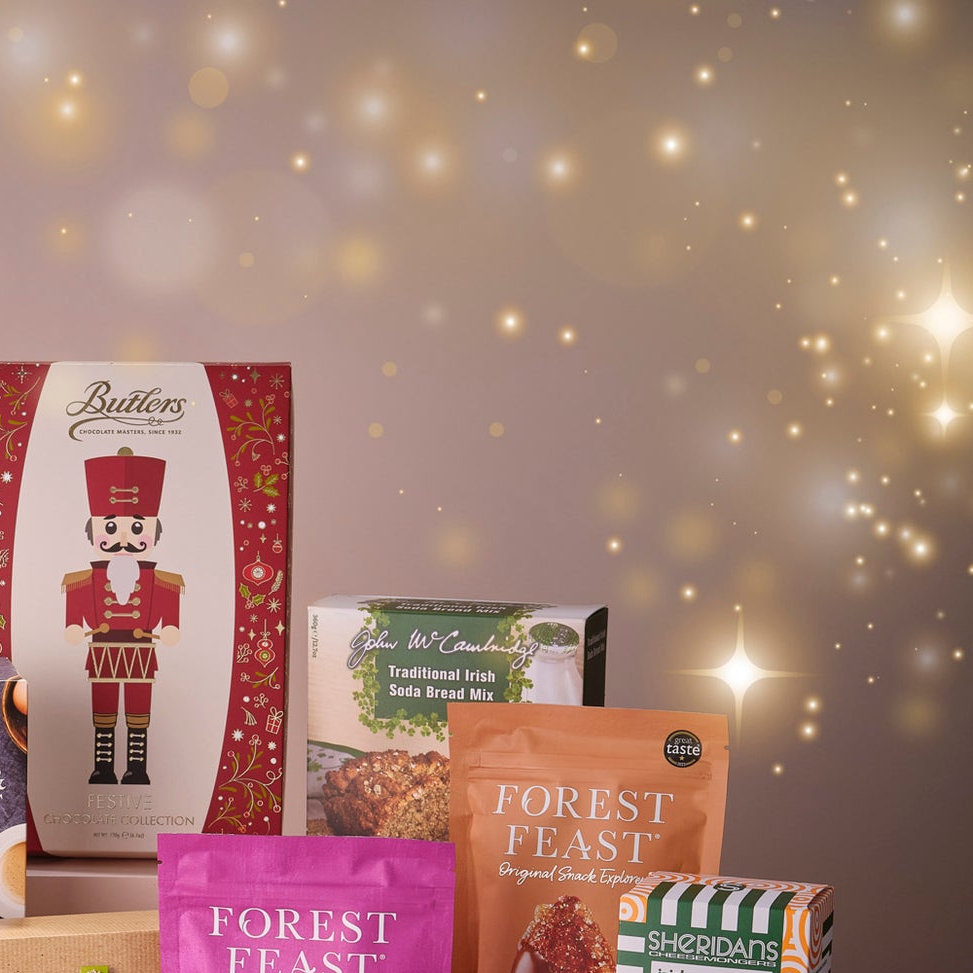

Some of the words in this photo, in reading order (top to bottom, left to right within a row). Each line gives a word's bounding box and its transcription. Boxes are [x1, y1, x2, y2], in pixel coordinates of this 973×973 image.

[65, 380, 187, 428] Butlers
[347, 630, 398, 669] John
[388, 665, 460, 681] Traditional
[465, 670, 496, 683] Irish
[389, 684, 421, 698] Soda
[426, 686, 465, 700] Bread
[470, 688, 494, 701] Mix
[667, 744, 701, 756] taste
[87, 793, 153, 811] FESTIVE
[492, 784, 674, 824] FOREST
[43, 813, 117, 826] CHOCOLATE
[120, 815, 195, 826] COLLECTION
[208, 906, 397, 944] FOREST
[648, 950, 777, 968] CHEESEMONGERS
